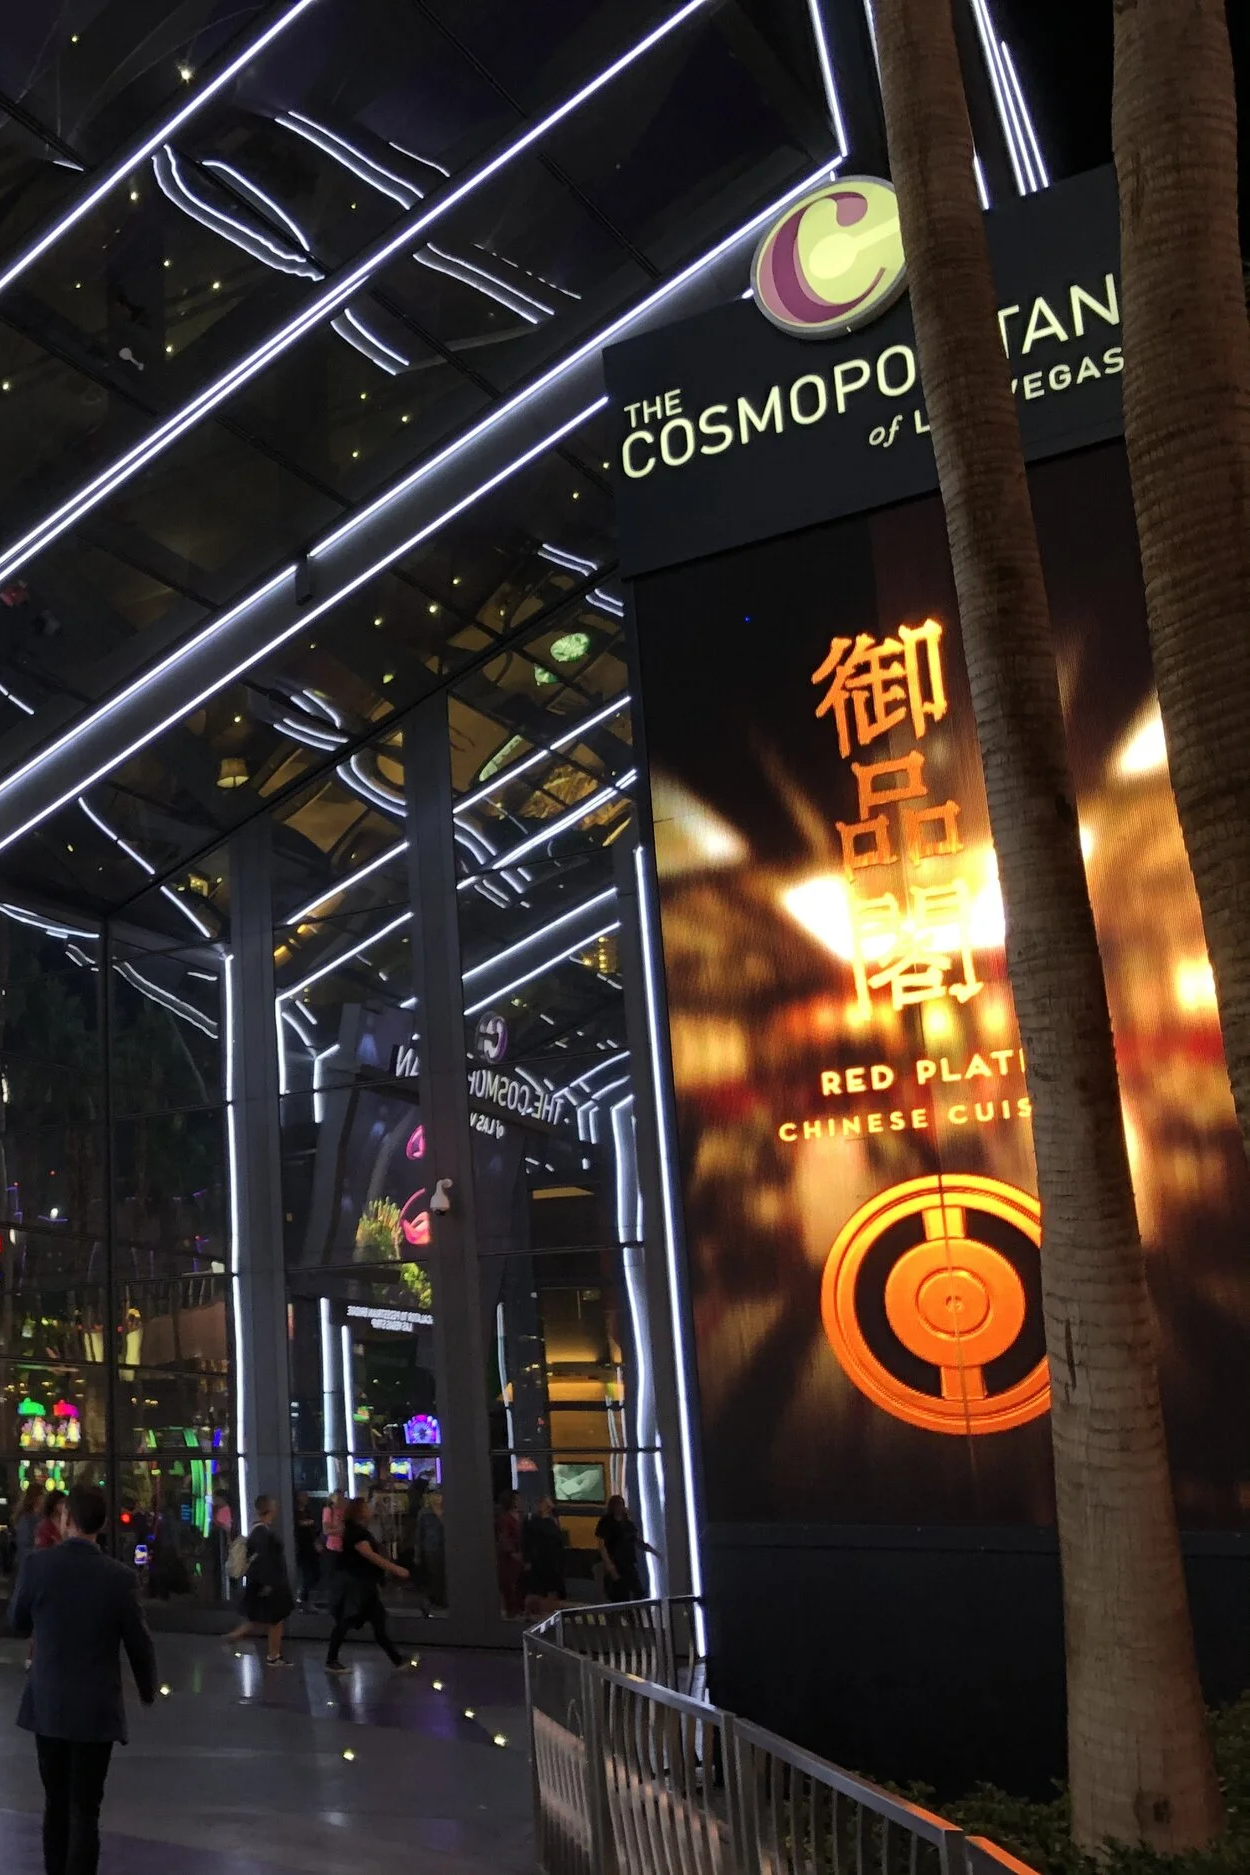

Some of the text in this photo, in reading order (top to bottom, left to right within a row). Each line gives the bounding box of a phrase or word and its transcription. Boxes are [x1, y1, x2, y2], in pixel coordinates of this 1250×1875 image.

[621, 273, 1121, 480] COSMOPOTAN
[623, 388, 683, 429] THE
[868, 413, 903, 449] of
[820, 1065, 895, 1097] RED
[778, 1097, 1032, 1143] CHINESE CUIS
